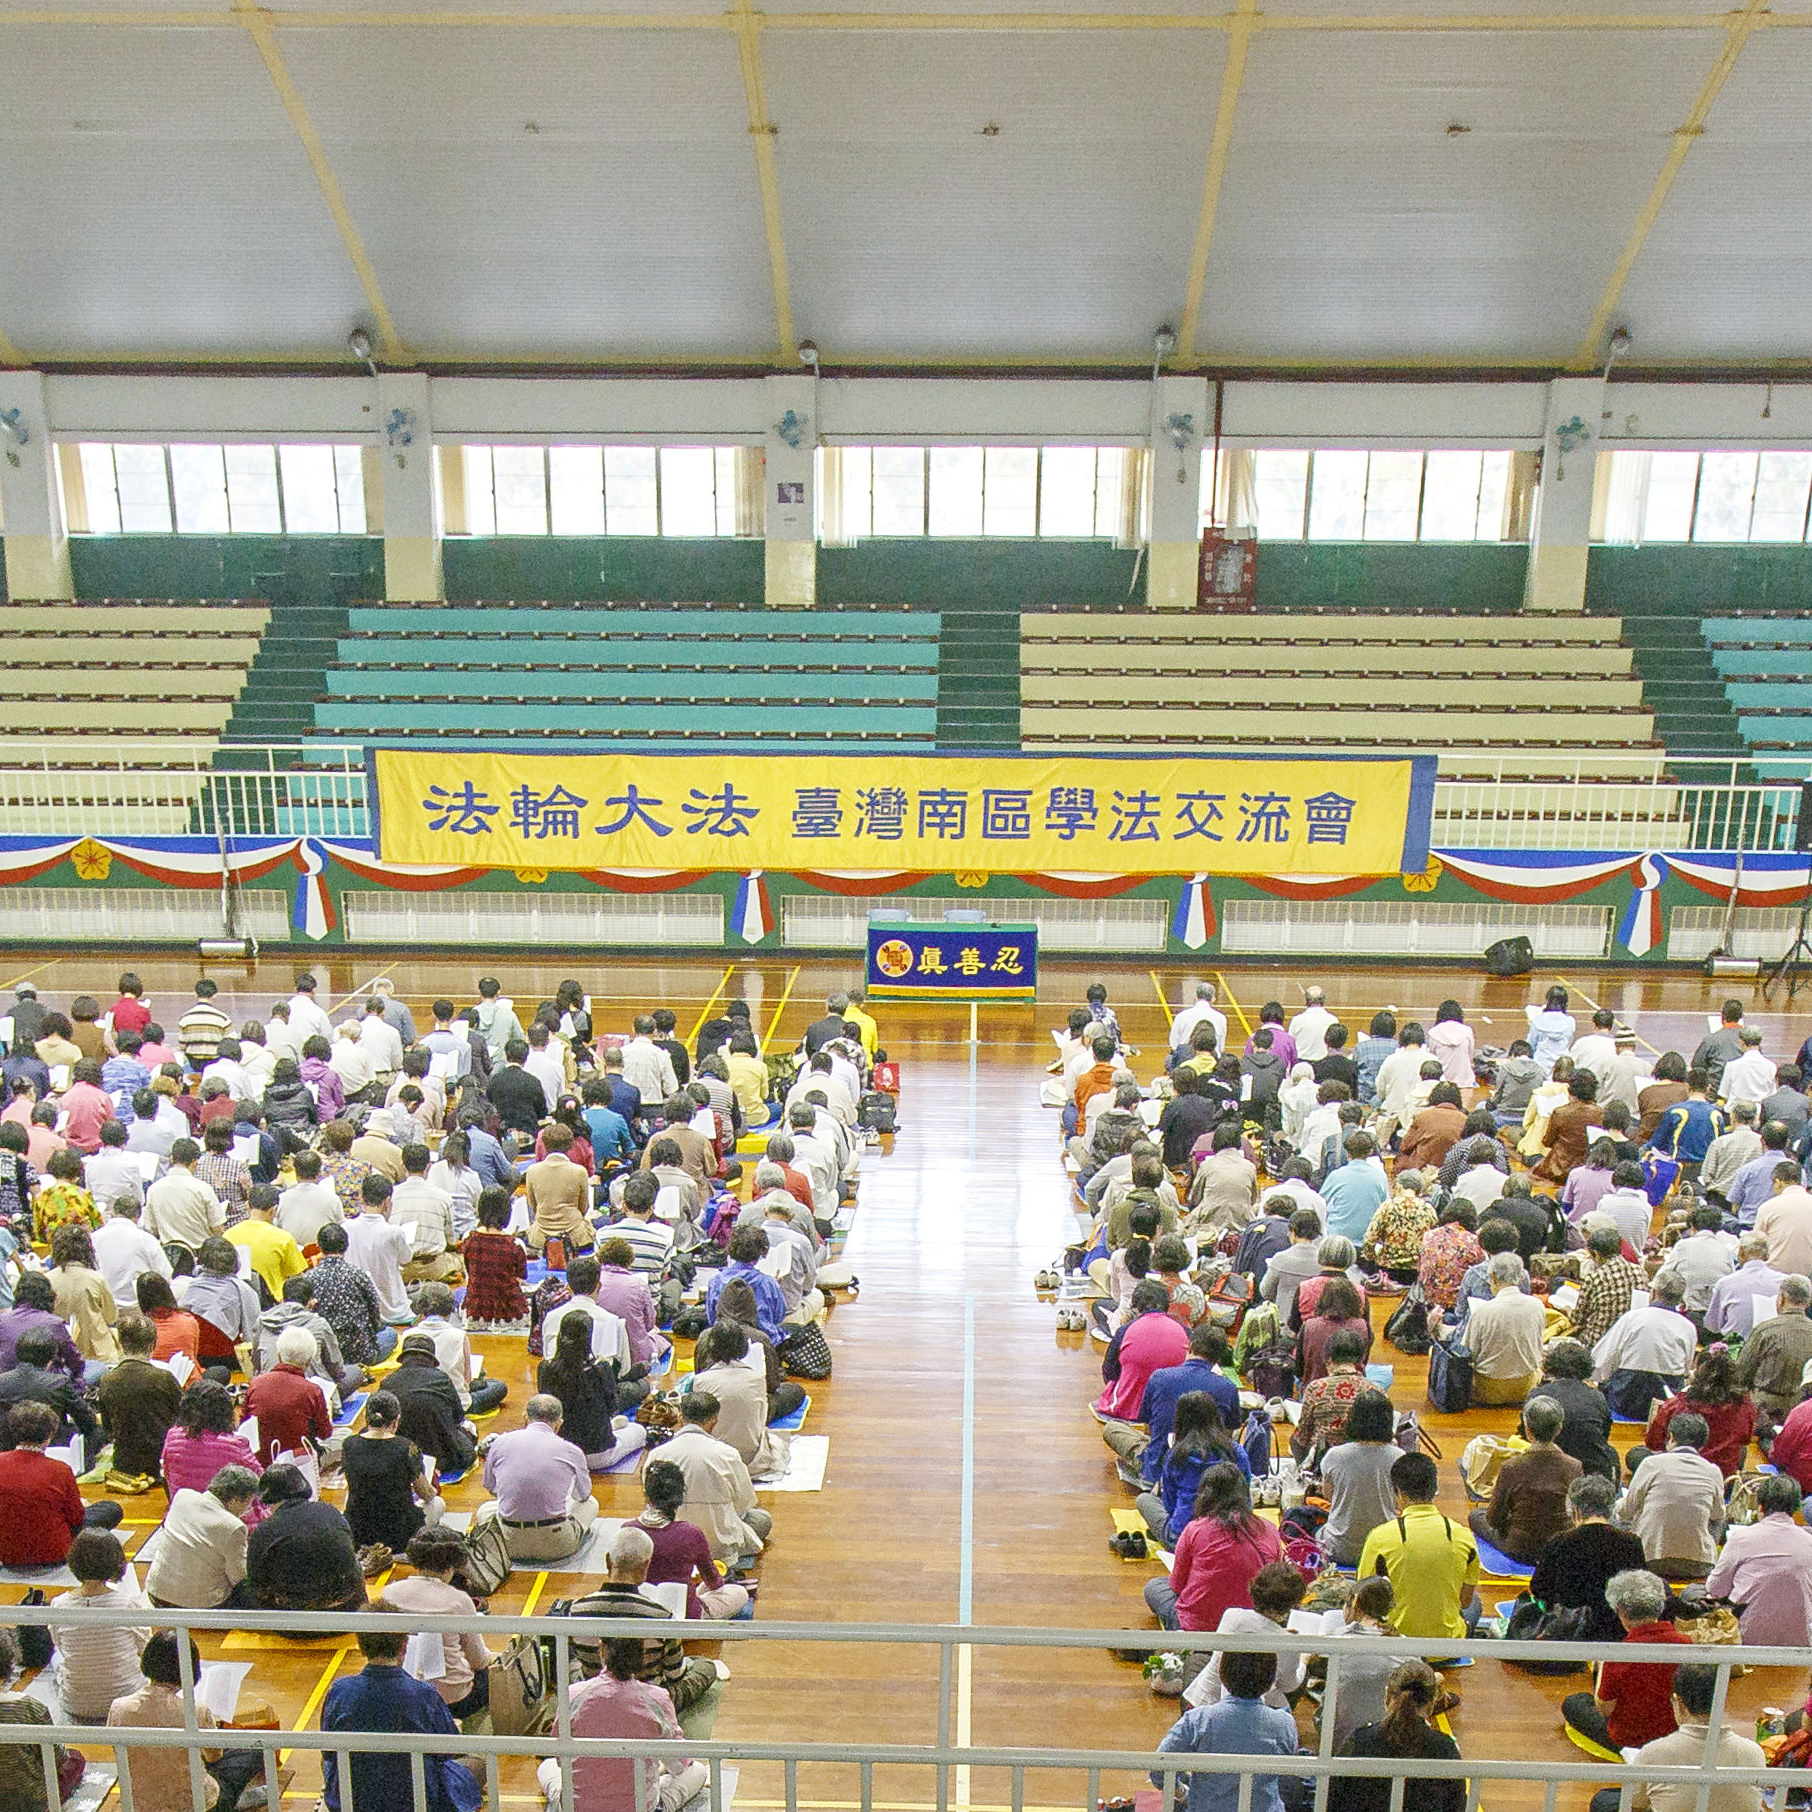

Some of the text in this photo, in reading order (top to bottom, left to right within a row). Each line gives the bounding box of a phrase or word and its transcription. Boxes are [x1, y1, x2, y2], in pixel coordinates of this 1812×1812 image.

[422, 780, 1357, 846] 法輪大法 臺灣南區學法交流會
